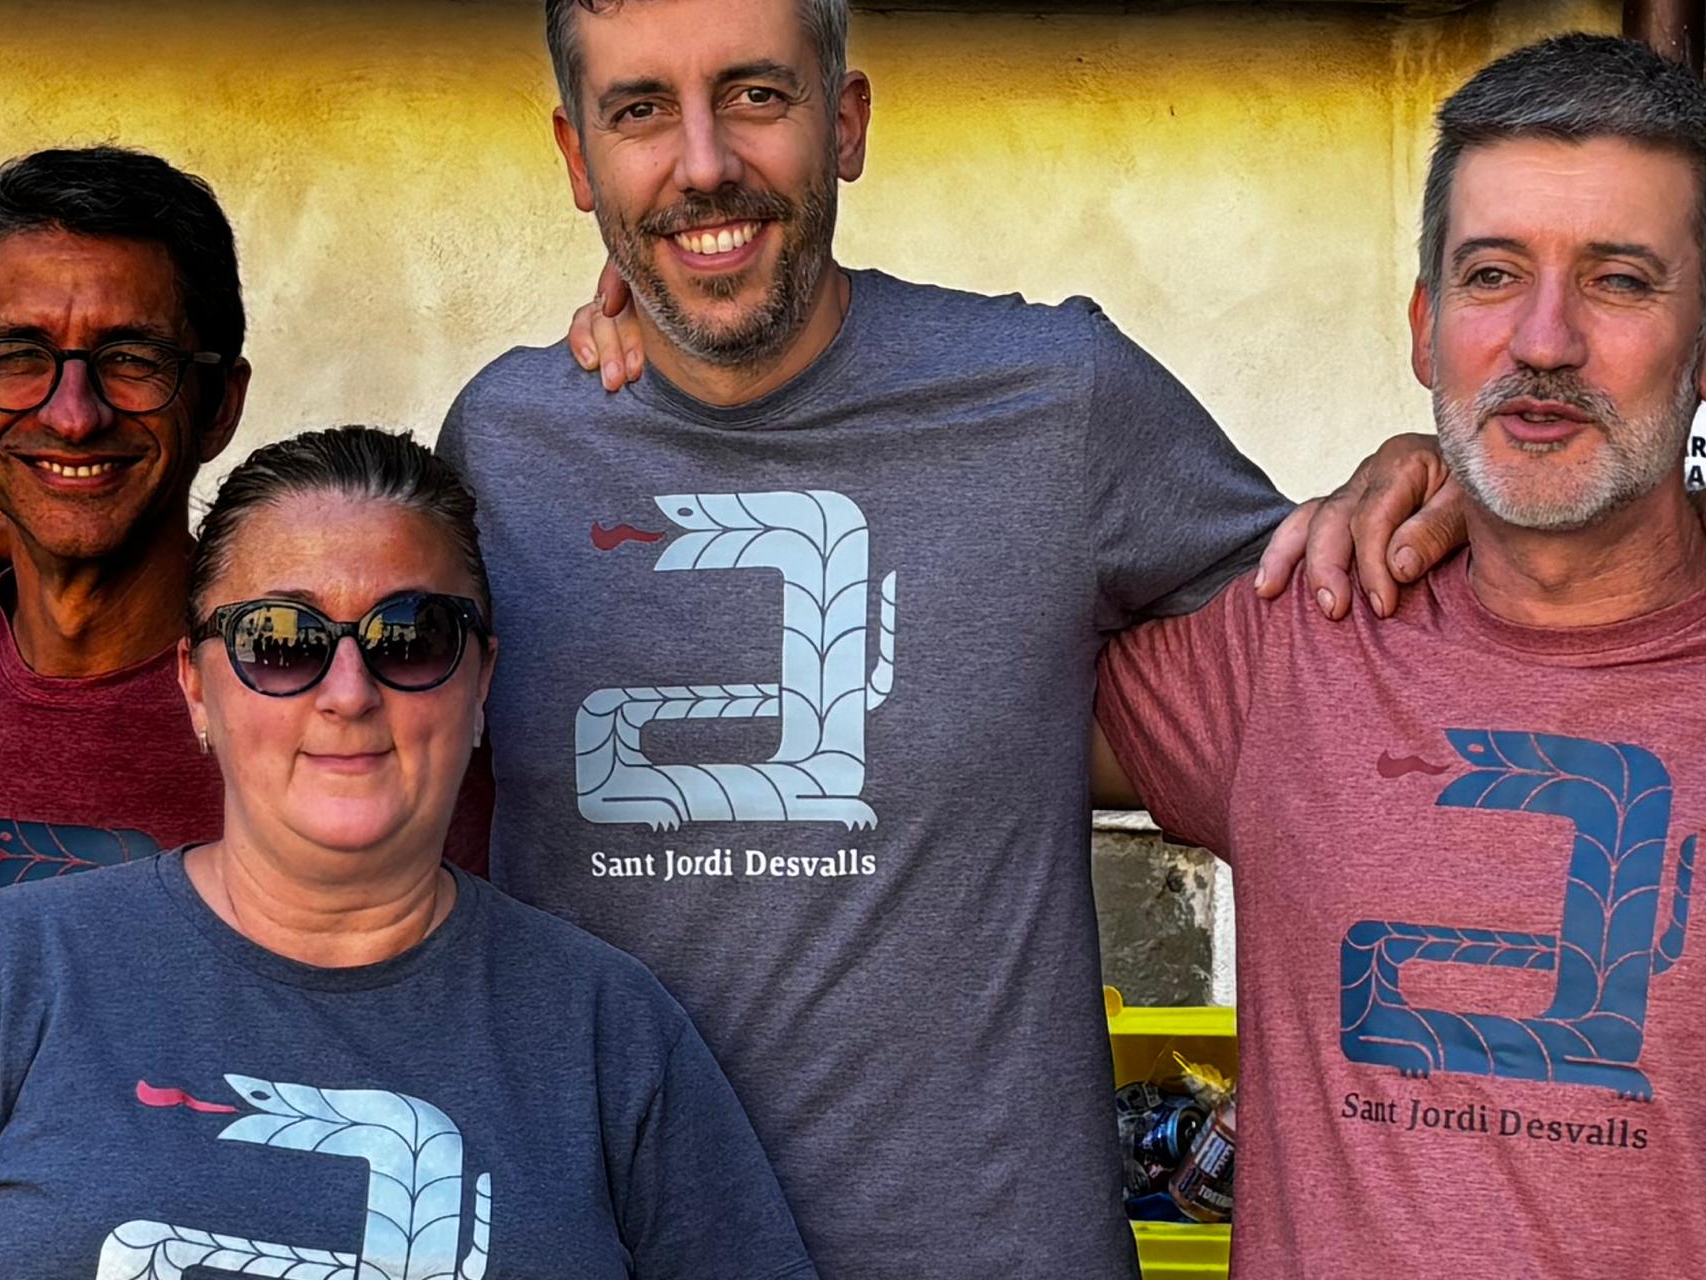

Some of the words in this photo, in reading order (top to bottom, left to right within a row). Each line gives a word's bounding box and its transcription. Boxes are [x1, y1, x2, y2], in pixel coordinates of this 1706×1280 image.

[591, 851, 655, 877] Sant
[664, 849, 733, 881] Jordi
[745, 849, 876, 877] Desvalls
[1341, 1093, 1397, 1124] Sant
[1407, 1099, 1489, 1133] Jordi
[1499, 1109, 1649, 1150] Desvalls
